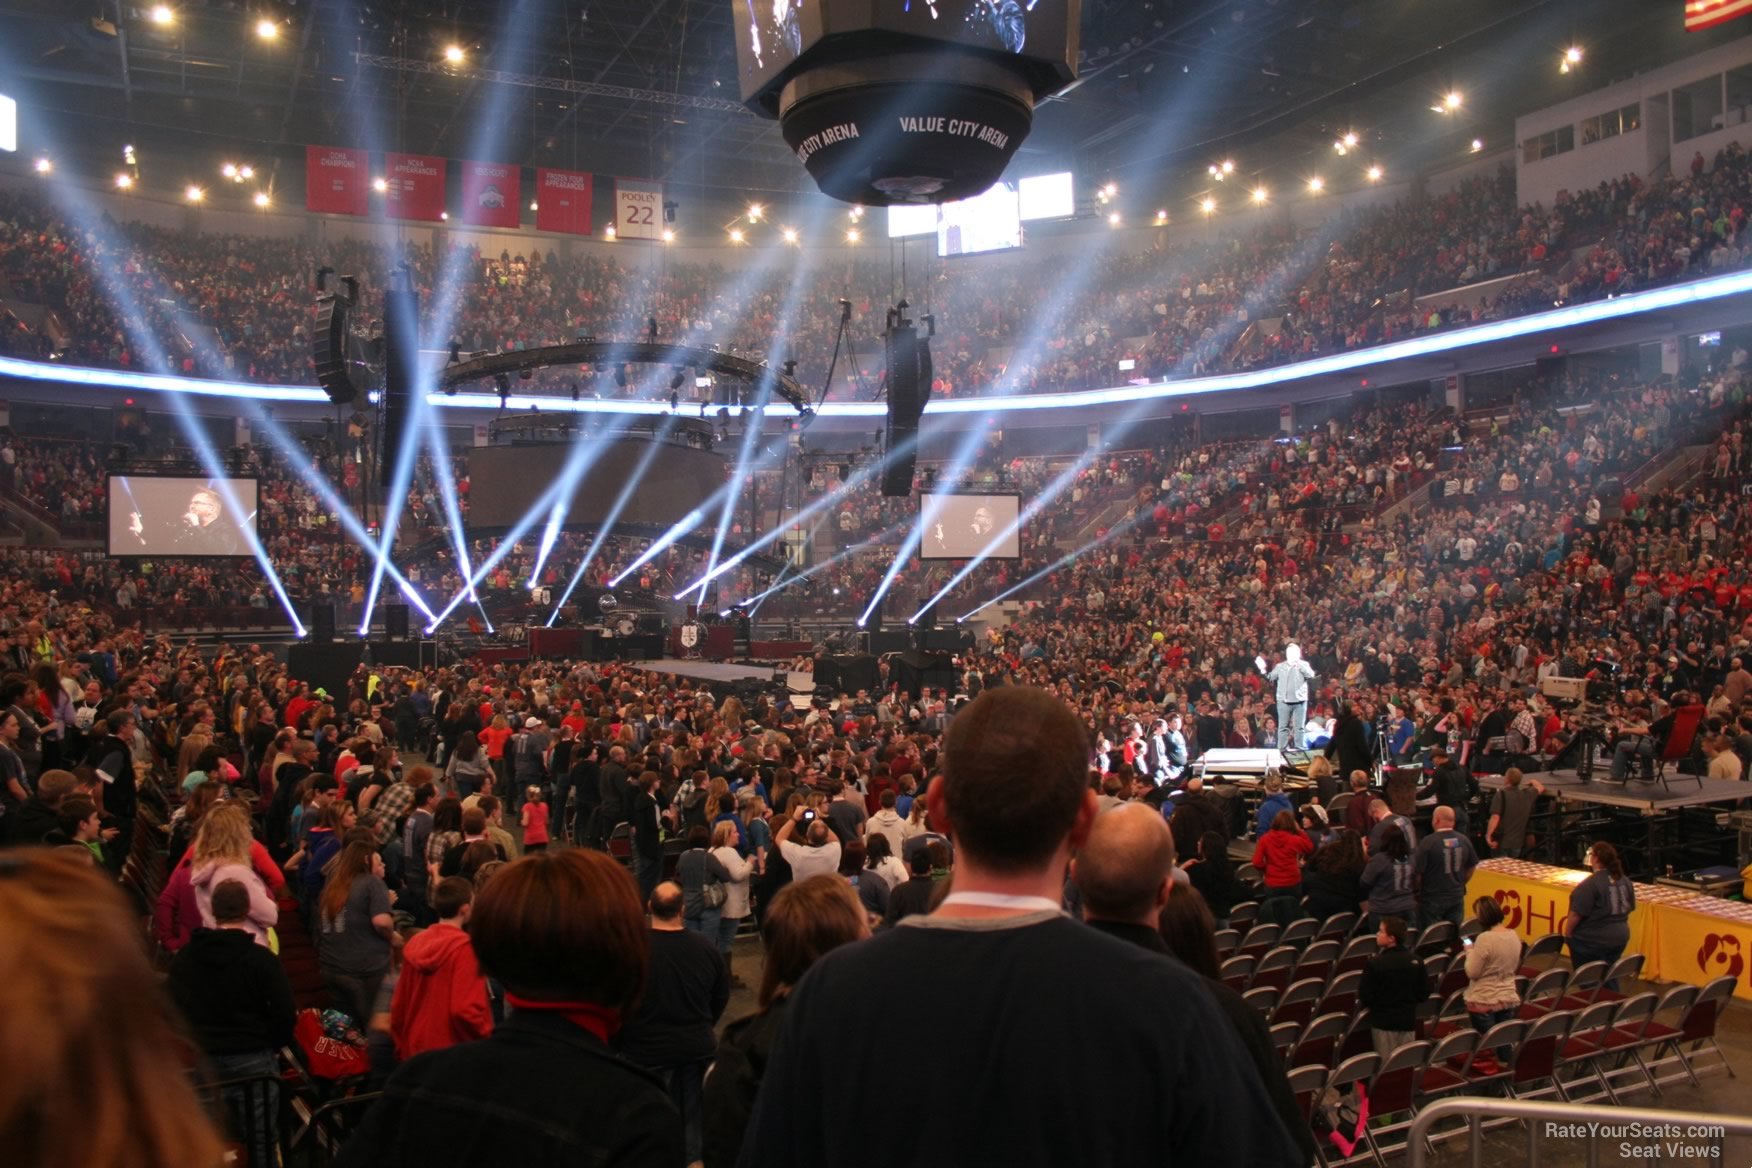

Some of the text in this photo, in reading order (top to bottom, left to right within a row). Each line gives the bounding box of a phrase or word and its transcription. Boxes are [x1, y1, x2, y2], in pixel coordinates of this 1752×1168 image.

[803, 133, 823, 154] CITY
[821, 122, 860, 147] ARENA
[899, 117, 1009, 150] VALUE CITY ARENA
[621, 192, 656, 203] POOLEY
[626, 205, 654, 225] 22
